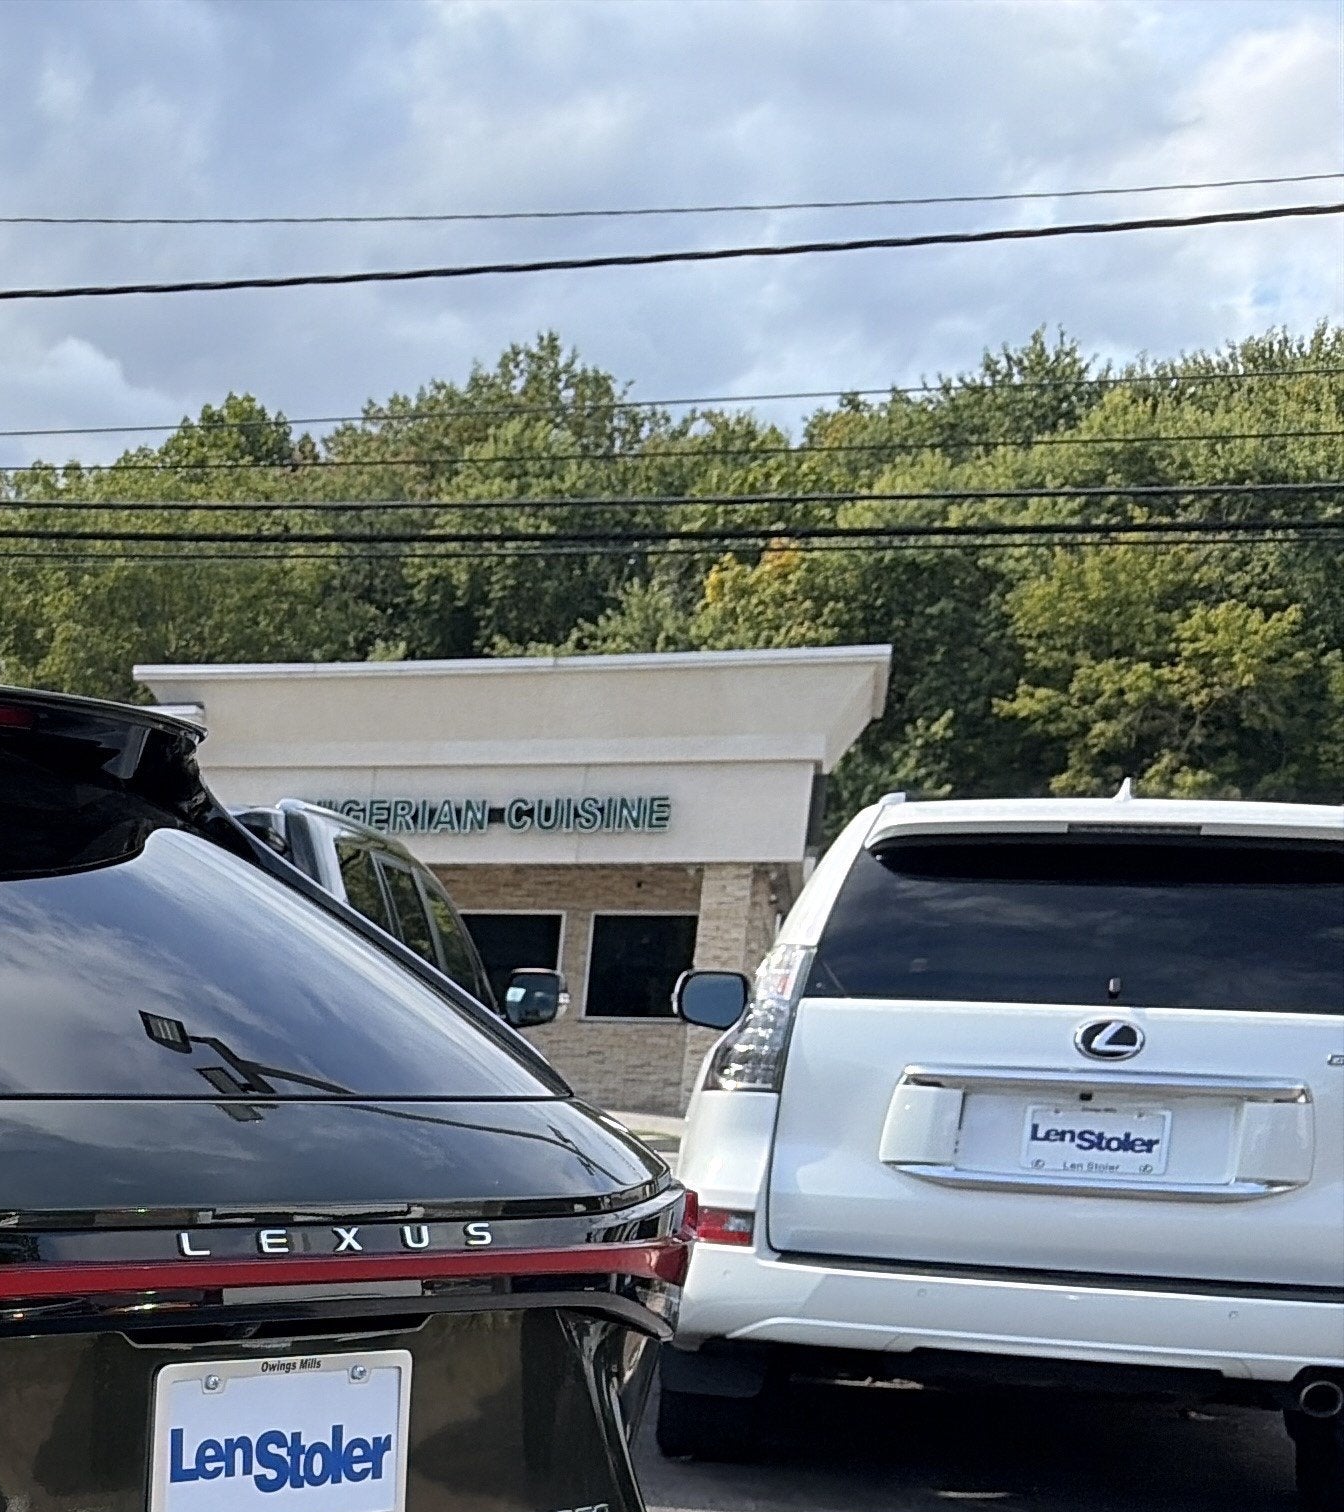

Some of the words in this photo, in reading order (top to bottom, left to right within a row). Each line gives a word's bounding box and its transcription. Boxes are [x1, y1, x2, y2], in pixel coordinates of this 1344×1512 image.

[316, 798, 489, 835] GERIAN
[505, 796, 672, 834] CUISINE
[179, 1222, 493, 1257] LEXUS
[261, 1360, 297, 1373] Owings
[299, 1358, 322, 1370] Mills
